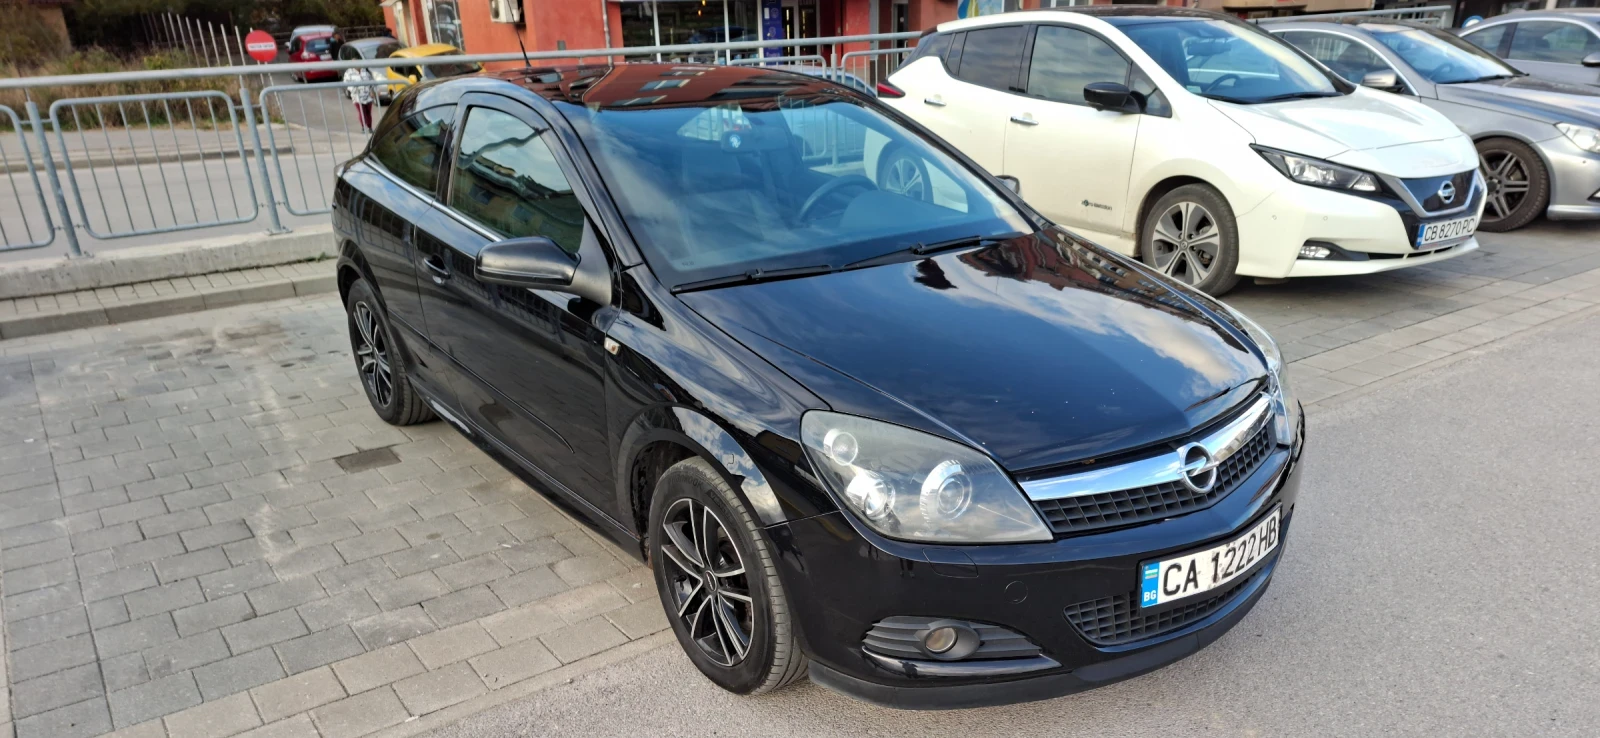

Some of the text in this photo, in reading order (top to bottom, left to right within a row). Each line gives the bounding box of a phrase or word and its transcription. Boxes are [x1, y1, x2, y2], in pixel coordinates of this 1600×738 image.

[1424, 218, 1475, 241] CB 8270 PC
[1163, 517, 1277, 596] CA 1222 HB
[1144, 590, 1157, 602] BG
